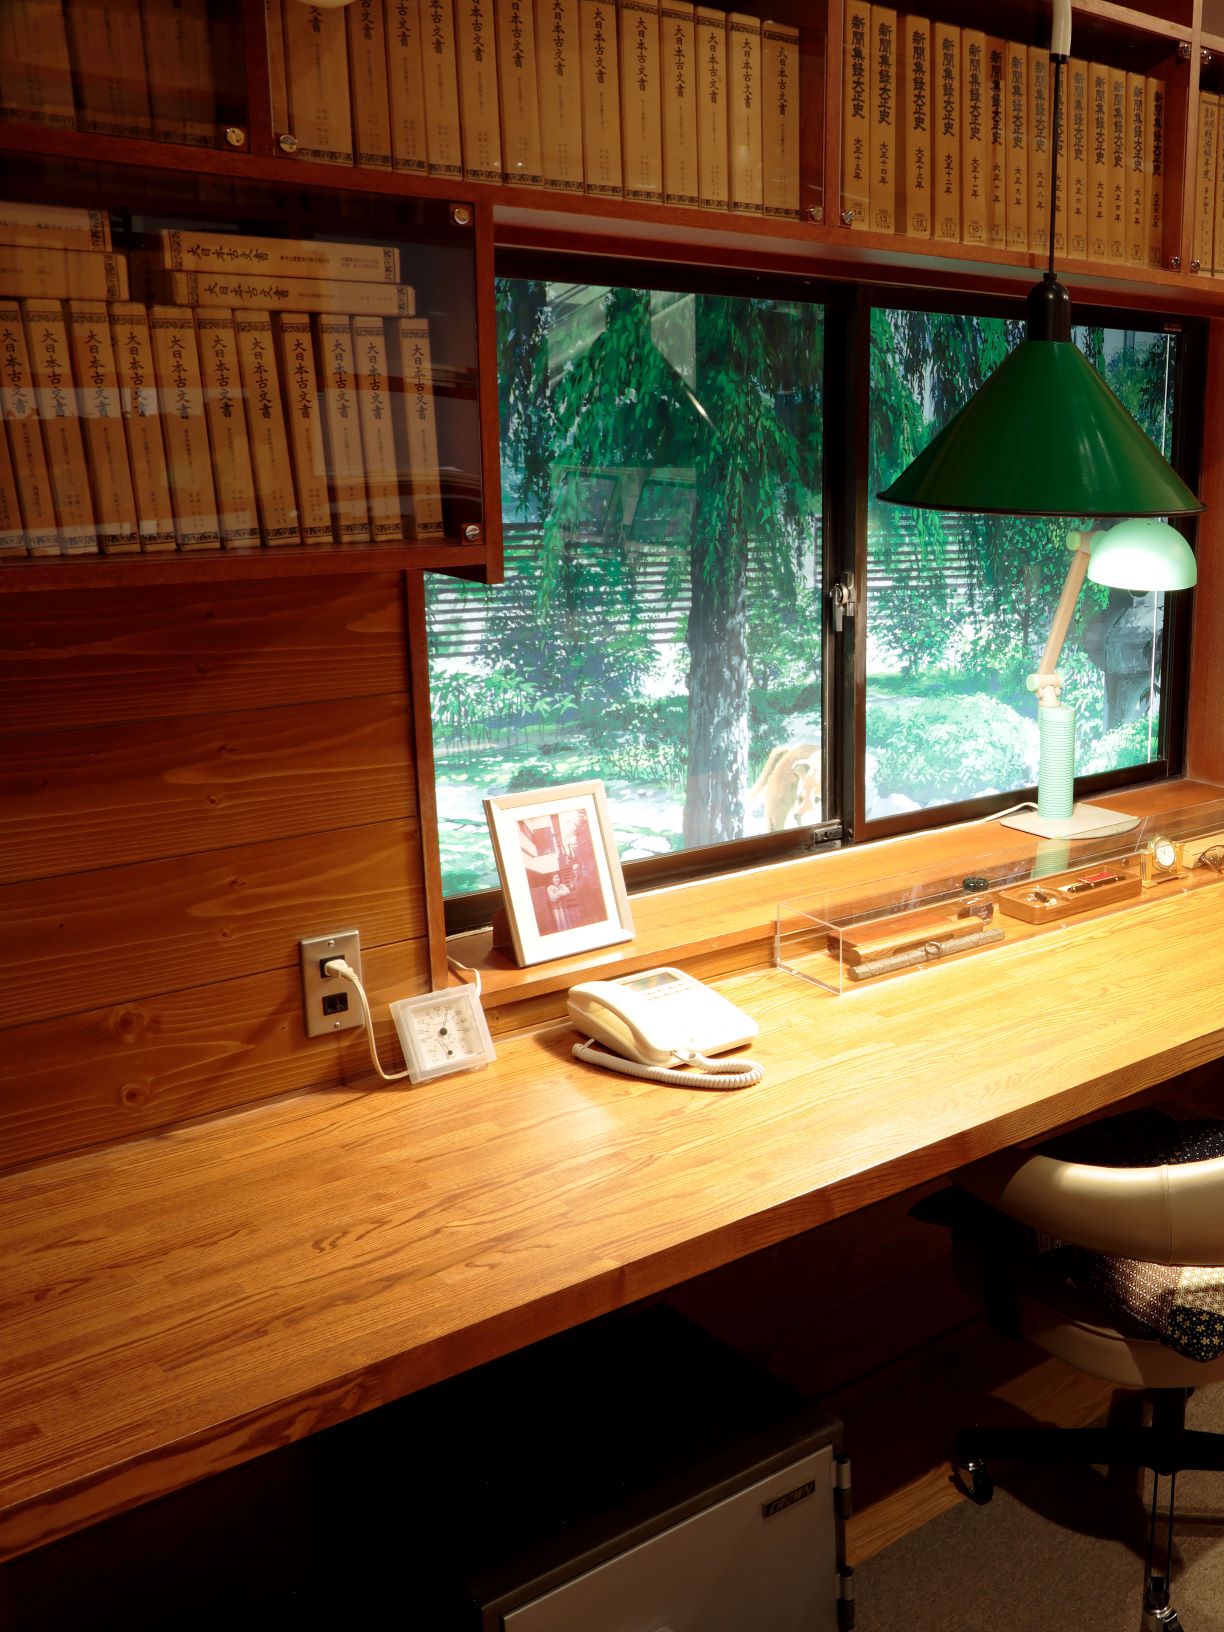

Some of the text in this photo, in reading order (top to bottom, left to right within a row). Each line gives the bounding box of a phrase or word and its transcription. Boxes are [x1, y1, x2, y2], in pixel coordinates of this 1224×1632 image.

[592, 7, 607, 85] 大日本古文書
[634, 16, 649, 93] 大日本古文書
[672, 24, 688, 99] 大日本古文書
[707, 31, 720, 105] 大日本古文書
[741, 37, 754, 110] 大日本古文書
[776, 46, 789, 117] 大日本古文書
[187, 244, 269, 264] 大日本古文書
[204, 281, 290, 301] 大日本古文書
[2, 328, 28, 415] 大日本古文書
[41, 328, 67, 418] 大日本古文書
[81, 330, 111, 418] 大日本古文書
[124, 331, 148, 418] 大日本古文書
[168, 335, 191, 420] 大日本古文書
[211, 334, 234, 418] 大日本古文書
[250, 337, 273, 420] 大日本古文書
[292, 338, 312, 419] 大日本古文書
[330, 339, 351, 418] 大日本古文書
[365, 341, 384, 421] 大日本古文書
[410, 344, 429, 421] 大日本古文書
